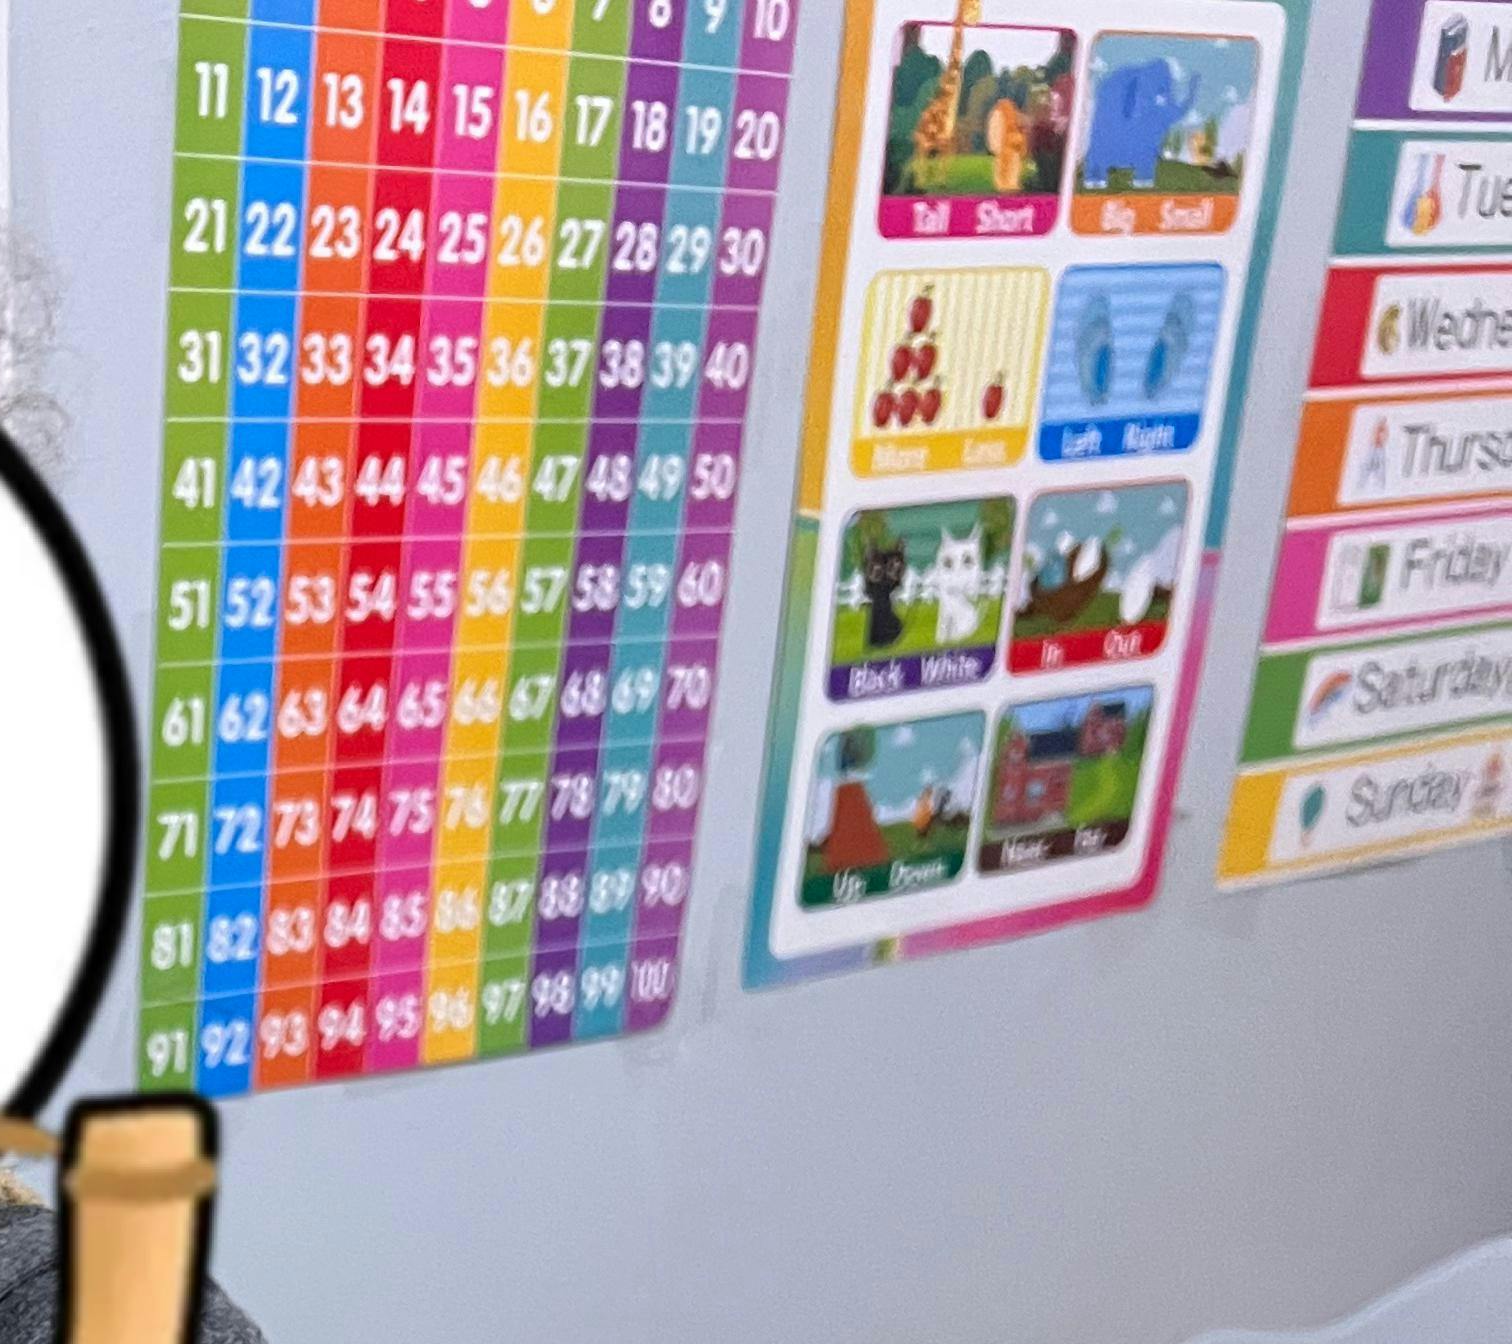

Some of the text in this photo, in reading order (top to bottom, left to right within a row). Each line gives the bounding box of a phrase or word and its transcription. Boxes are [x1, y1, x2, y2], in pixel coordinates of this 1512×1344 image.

[752, 0, 789, 41] 10
[195, 62, 780, 160] 11 12 13 14 15 16 17 18 19 20
[184, 198, 764, 275] 21 22 23 24 25 26 27 28 29 30
[179, 330, 749, 389] 31 32 33 34 35 36 37 38 39 40
[174, 458, 215, 507] 41
[230, 458, 281, 508] 42
[294, 458, 343, 508] 43
[354, 457, 405, 505] 44
[417, 456, 466, 504] 45
[533, 455, 583, 501] 47
[585, 455, 631, 501] 48
[638, 455, 686, 499] 49
[691, 454, 736, 499] 50
[169, 561, 722, 630] 51 52 53 54 55 56 57 58 59 60
[163, 697, 204, 746] 61
[218, 695, 268, 742] 62
[278, 691, 327, 738] 63
[337, 685, 387, 733] 64
[397, 681, 445, 729] 65
[509, 674, 557, 720] 67
[561, 671, 606, 716] 68
[612, 668, 660, 713] 69
[668, 665, 711, 708] 70
[158, 811, 198, 859] 71
[214, 805, 262, 853] 72
[273, 802, 319, 847] 73
[331, 794, 377, 841] 74
[390, 788, 436, 835] 75
[500, 778, 545, 823] 77
[653, 766, 700, 809] 80
[152, 922, 192, 970] 81
[207, 914, 256, 964] 82
[266, 908, 314, 954] 83
[324, 901, 370, 947] 84
[381, 896, 426, 940] 85
[642, 863, 685, 907] 90
[147, 1029, 188, 1076] 91
[201, 1019, 252, 1065] 92
[259, 1012, 308, 1057] 93
[318, 1004, 366, 1049] 94
[376, 994, 422, 1040] 95
[482, 978, 527, 1023] 97
